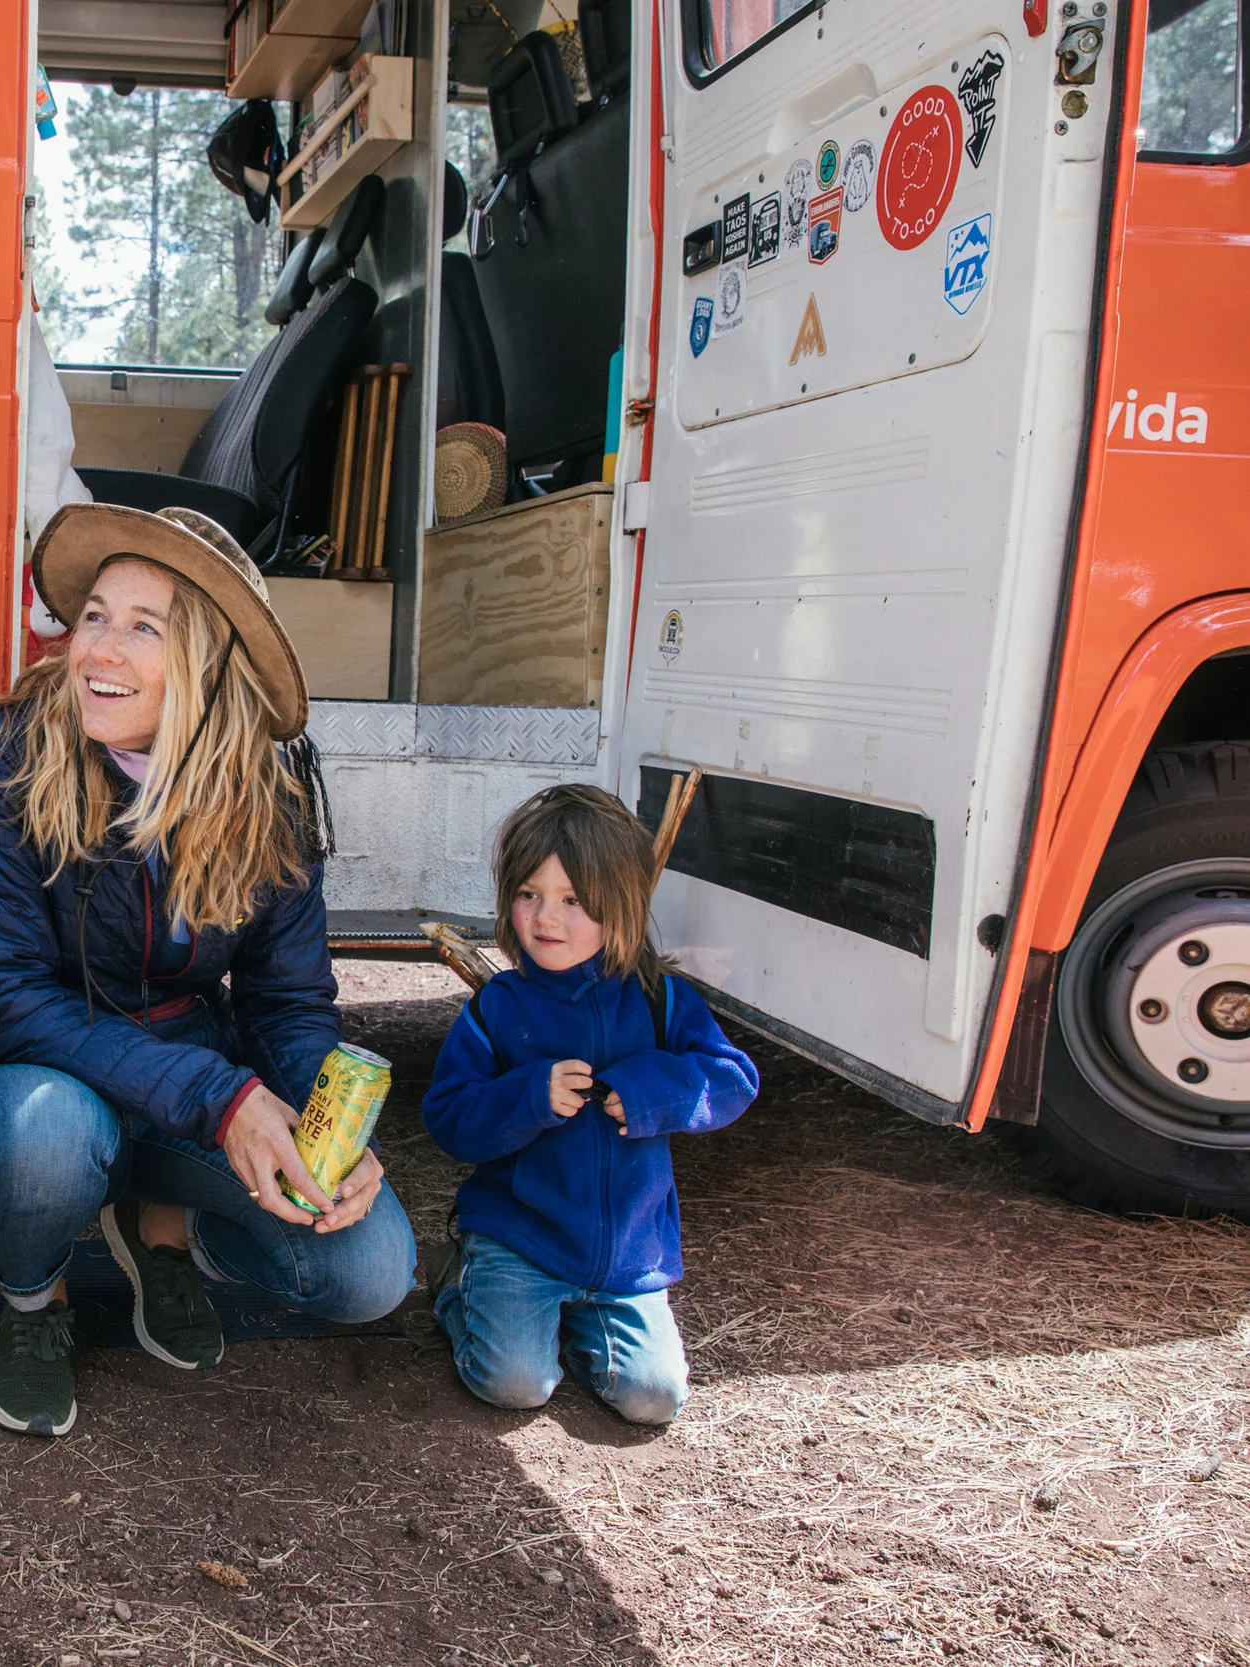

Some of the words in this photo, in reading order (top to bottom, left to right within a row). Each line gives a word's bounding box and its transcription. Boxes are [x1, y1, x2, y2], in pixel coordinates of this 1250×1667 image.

[902, 97, 945, 127] GOOD
[727, 201, 746, 219] MAKE
[725, 213, 747, 233] TAOS
[891, 208, 936, 240] TO-GO
[725, 227, 747, 245] KOSHER
[724, 239, 746, 257] AGAIN
[945, 249, 990, 292] VTX
[312, 1089, 333, 1107] AYAKI
[299, 1116, 323, 1140] ATE
